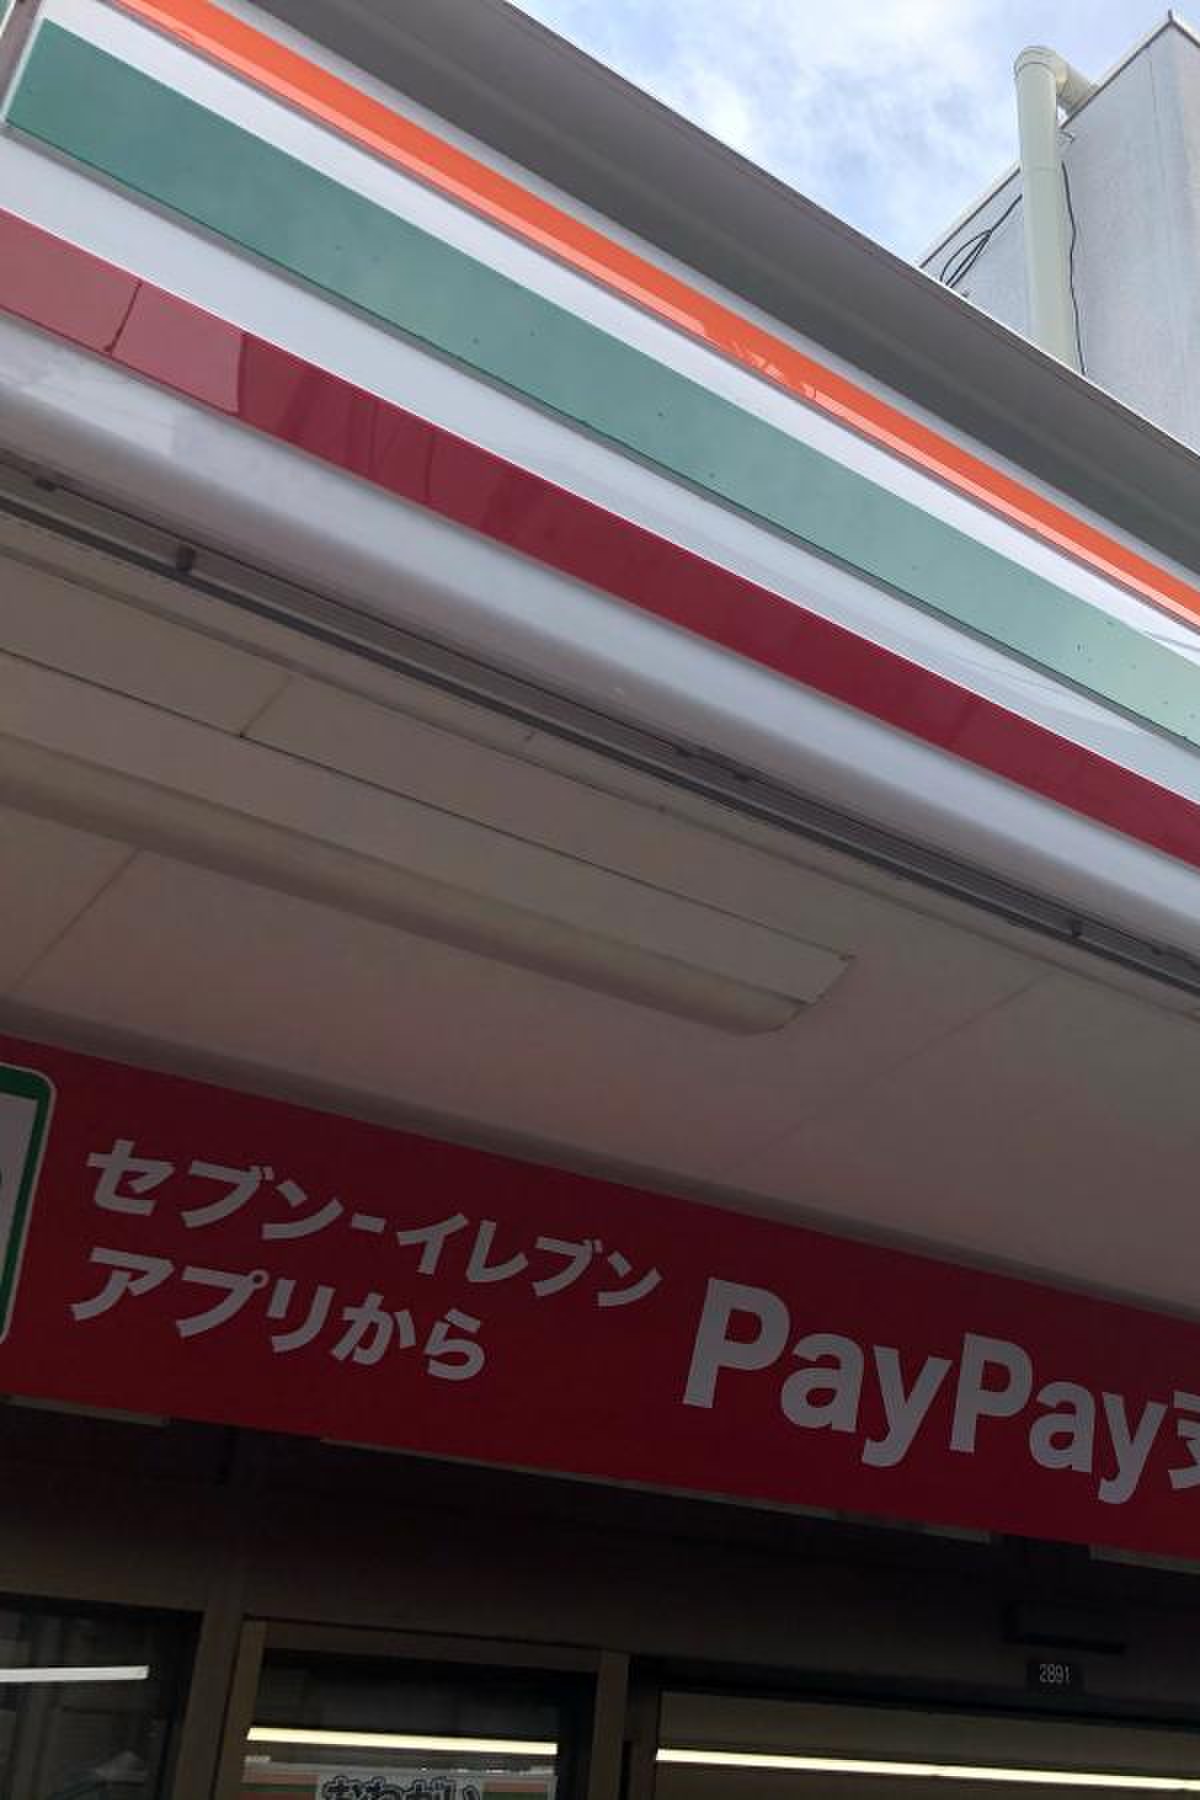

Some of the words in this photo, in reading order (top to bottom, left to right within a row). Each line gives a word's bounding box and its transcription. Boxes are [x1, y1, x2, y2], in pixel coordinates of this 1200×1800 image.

[70, 1246, 486, 1381] アプリから
